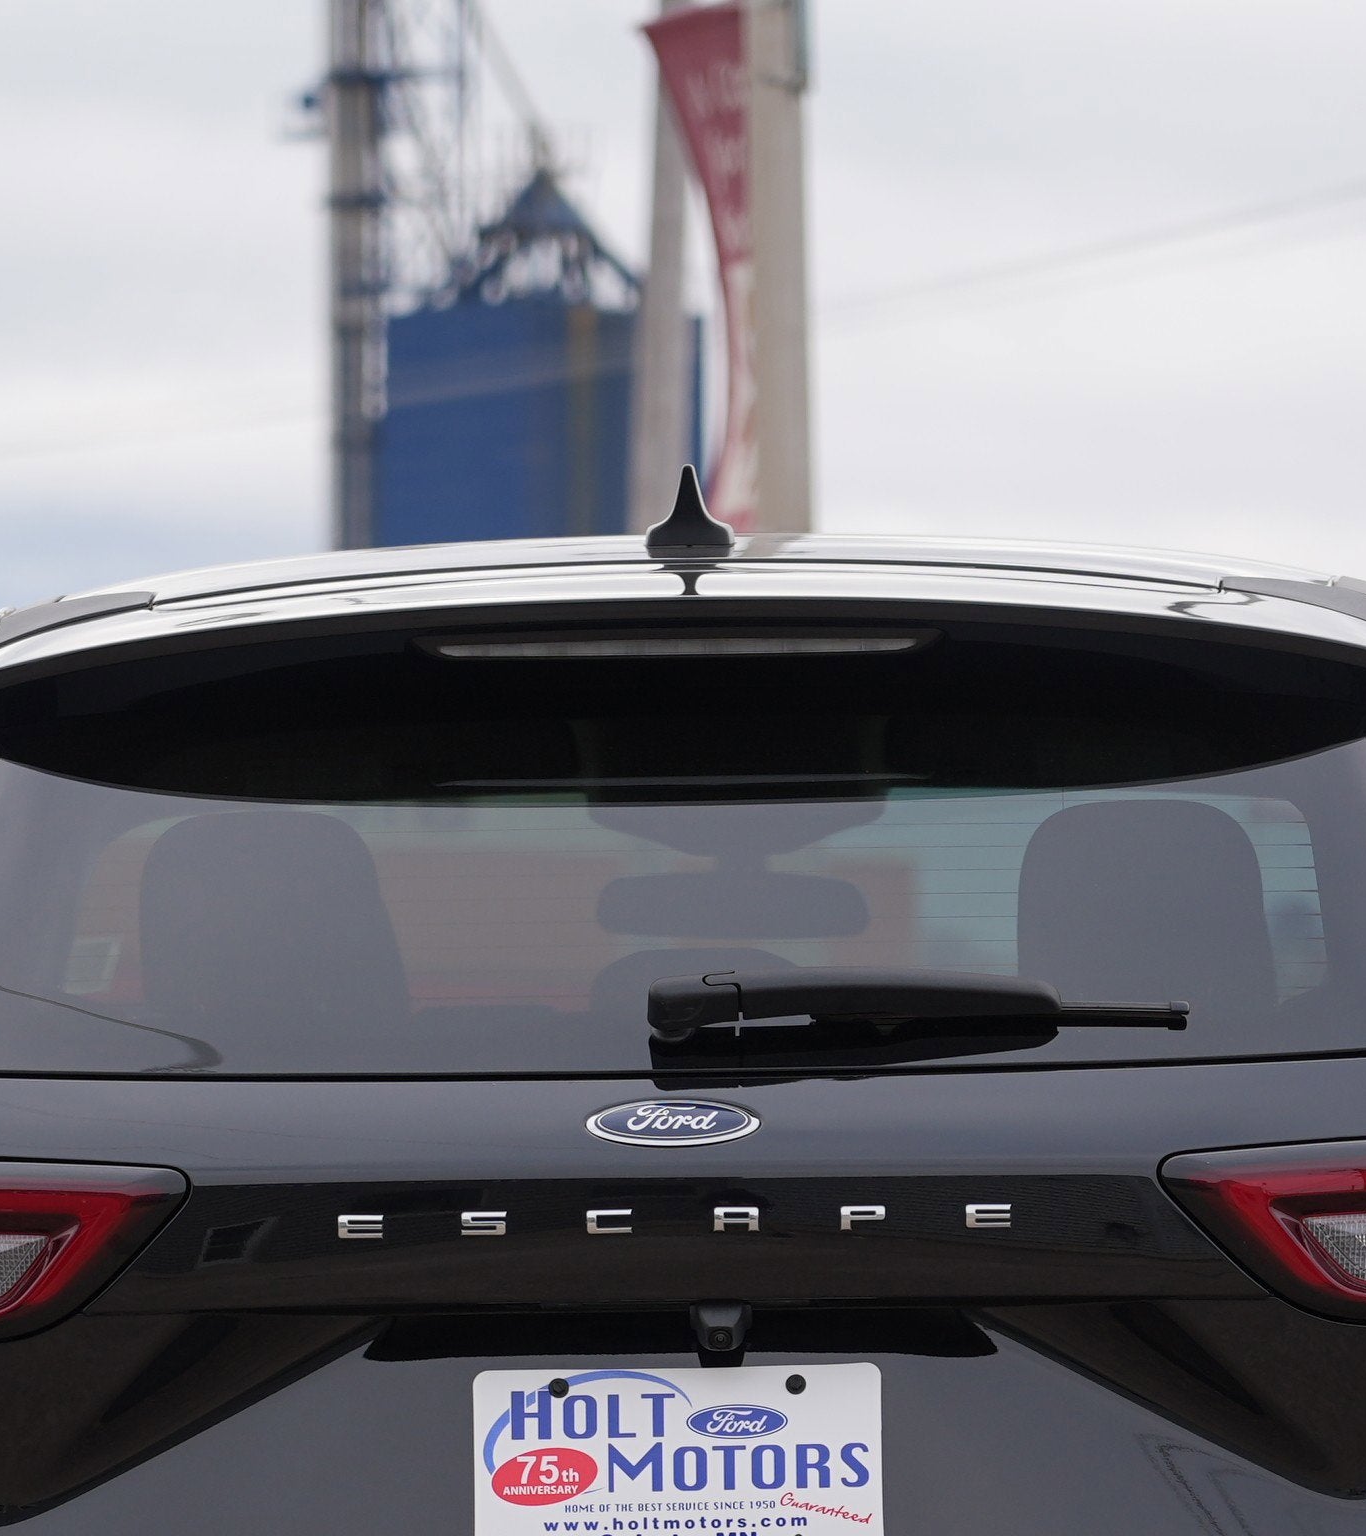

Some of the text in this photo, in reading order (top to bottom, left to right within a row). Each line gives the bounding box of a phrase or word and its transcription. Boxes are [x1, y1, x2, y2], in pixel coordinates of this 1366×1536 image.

[627, 1103, 717, 1132] Ford
[337, 1203, 1012, 1240] ESCAPE
[511, 1391, 675, 1440] HOLT
[706, 1409, 767, 1434] Ford
[517, 1455, 580, 1484] 75th
[608, 1442, 870, 1493] MOTORS
[503, 1485, 579, 1496] ANNIVERSARY
[565, 1500, 776, 1513] HOME OF THE BEST SERVICE SINCE 1950
[780, 1491, 873, 1525] Guaranteed
[544, 1515, 808, 1532] www.holtmotors.com
